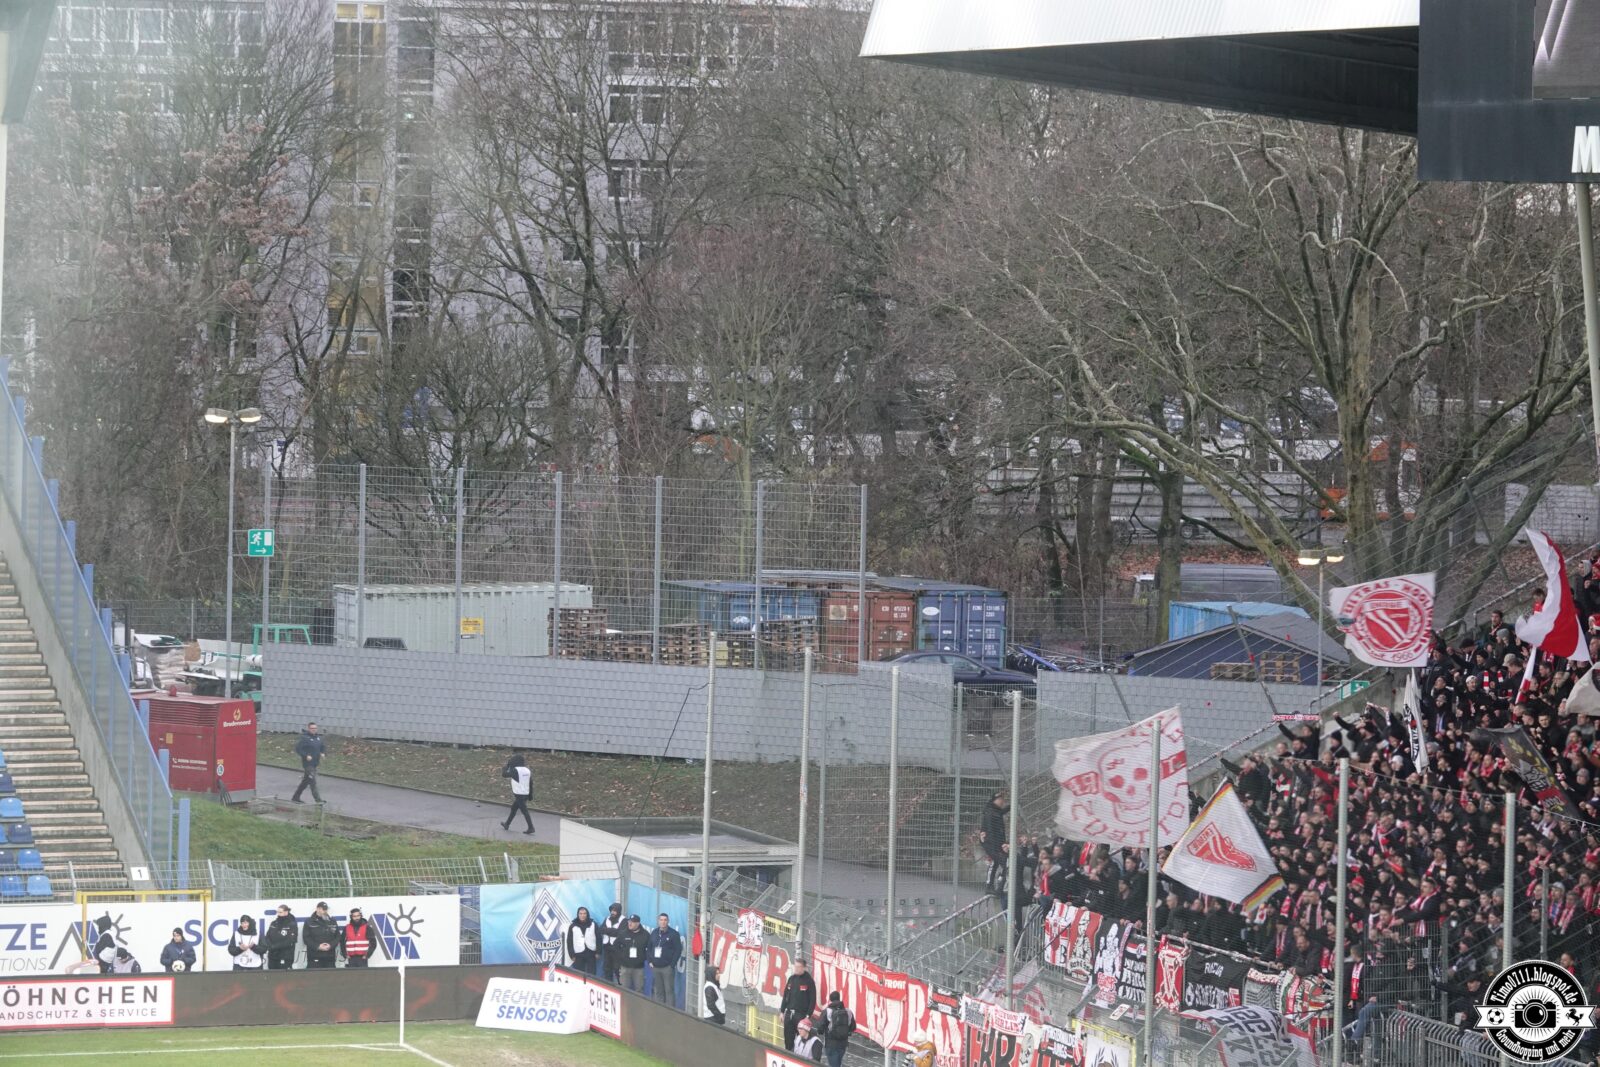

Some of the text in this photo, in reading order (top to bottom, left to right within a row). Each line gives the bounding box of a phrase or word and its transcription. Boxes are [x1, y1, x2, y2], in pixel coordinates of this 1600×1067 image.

[531, 938, 563, 949] WALDHO
[541, 950, 556, 962] 07
[3, 985, 158, 1007] ÖHNCHEN
[490, 988, 563, 1008] RECHNER
[86, 1009, 93, 1018] &
[100, 1008, 157, 1018] SERVICE
[496, 1005, 568, 1024] SENSORS
